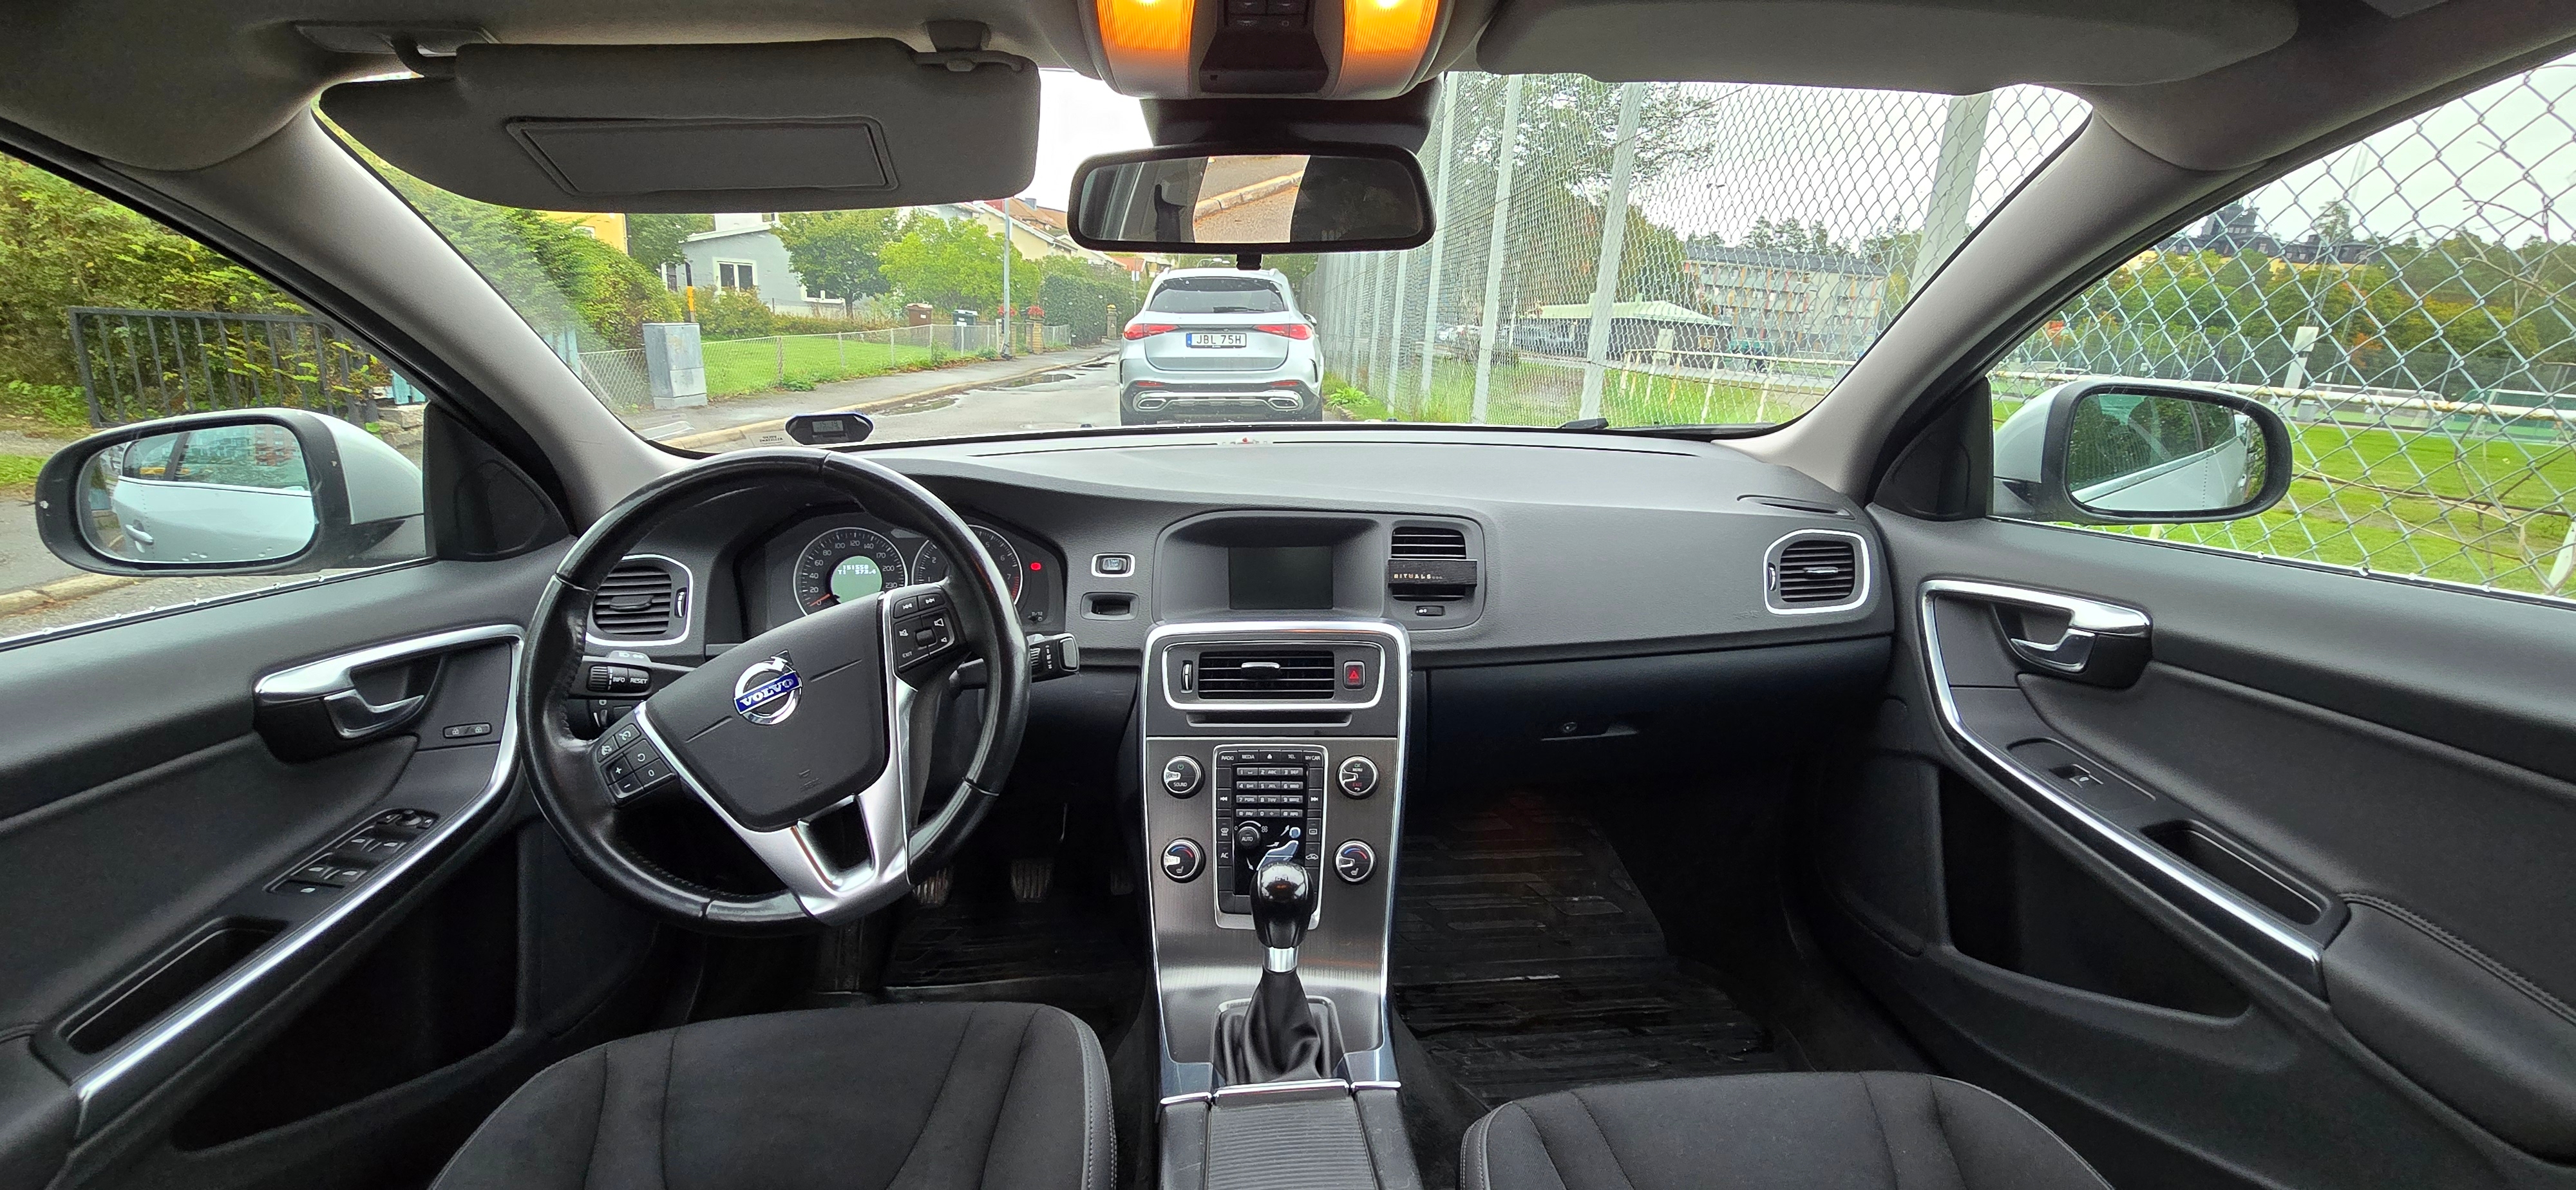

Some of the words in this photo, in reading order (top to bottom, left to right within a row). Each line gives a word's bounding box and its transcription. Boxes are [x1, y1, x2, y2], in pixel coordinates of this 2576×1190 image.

[1197, 335, 1216, 344] JBL
[1220, 335, 1241, 344] 75H
[739, 678, 794, 706] VOLVO
